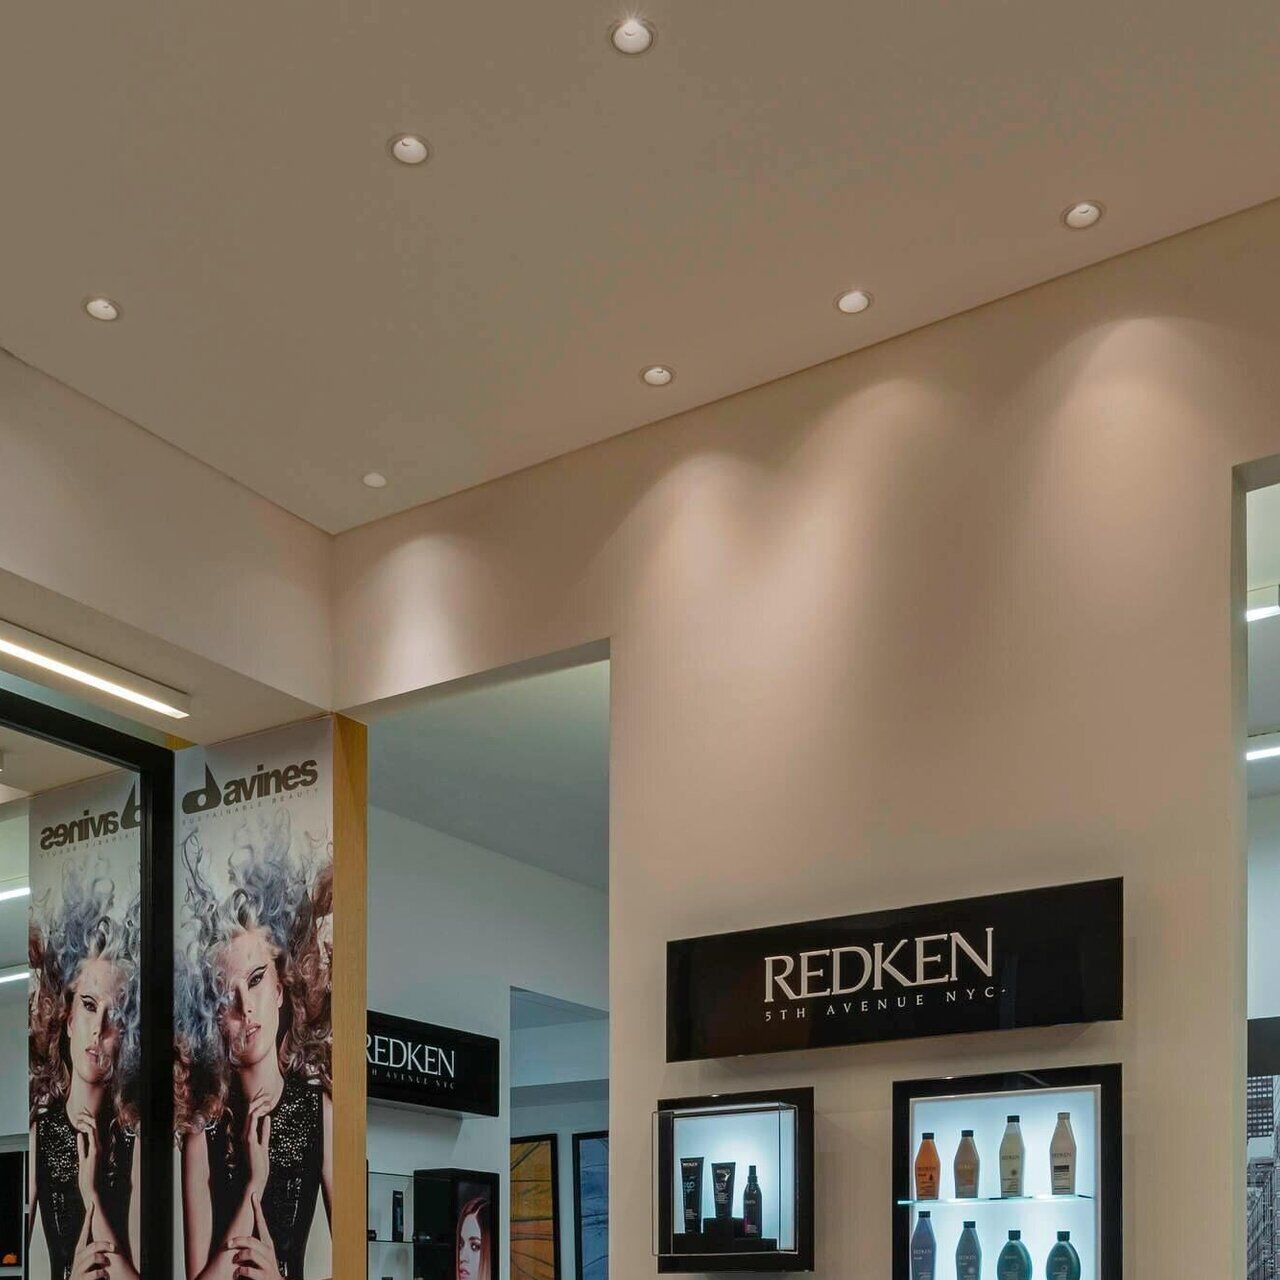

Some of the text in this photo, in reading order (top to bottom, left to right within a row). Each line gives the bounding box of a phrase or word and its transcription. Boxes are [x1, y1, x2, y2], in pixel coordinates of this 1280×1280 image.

[182, 759, 320, 815] davines
[763, 927, 995, 1003] REDKEN
[765, 1006, 807, 1022] 5TH
[826, 993, 925, 1016] AVENUE
